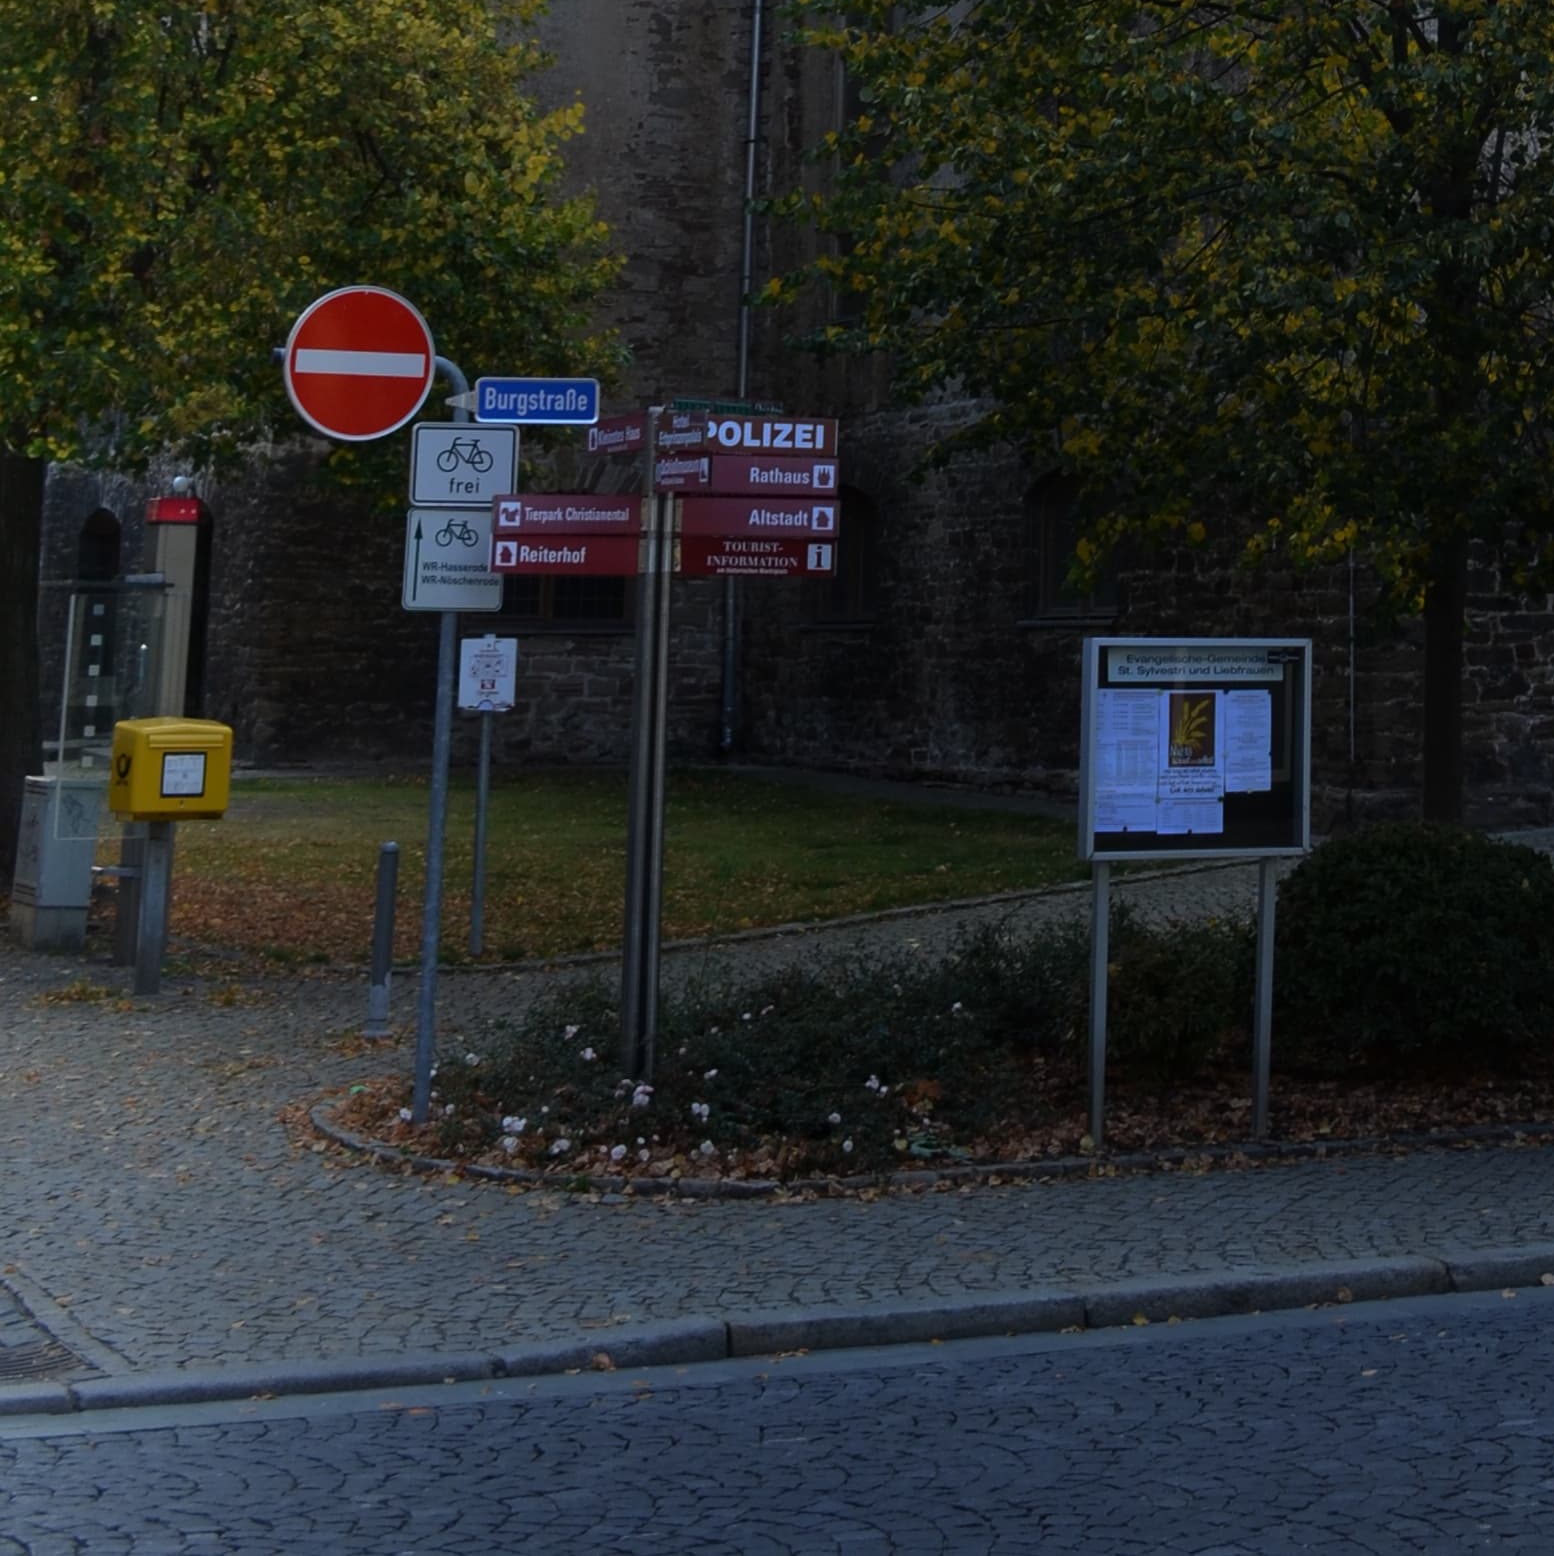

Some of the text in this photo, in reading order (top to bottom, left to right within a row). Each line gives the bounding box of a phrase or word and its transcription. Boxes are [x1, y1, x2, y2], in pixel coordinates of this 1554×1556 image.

[484, 386, 588, 416] Burgstraße
[749, 467, 810, 484] Rathaus
[449, 478, 480, 494] frei
[525, 506, 630, 524] Tierpark Christianental
[748, 509, 809, 527] Altstadt
[519, 545, 587, 564] Reiterhof
[722, 541, 784, 553] TOURIST-
[706, 555, 798, 568] INFORMATION
[1118, 665, 1275, 678] St. Sylvestri und Liebfrauen
